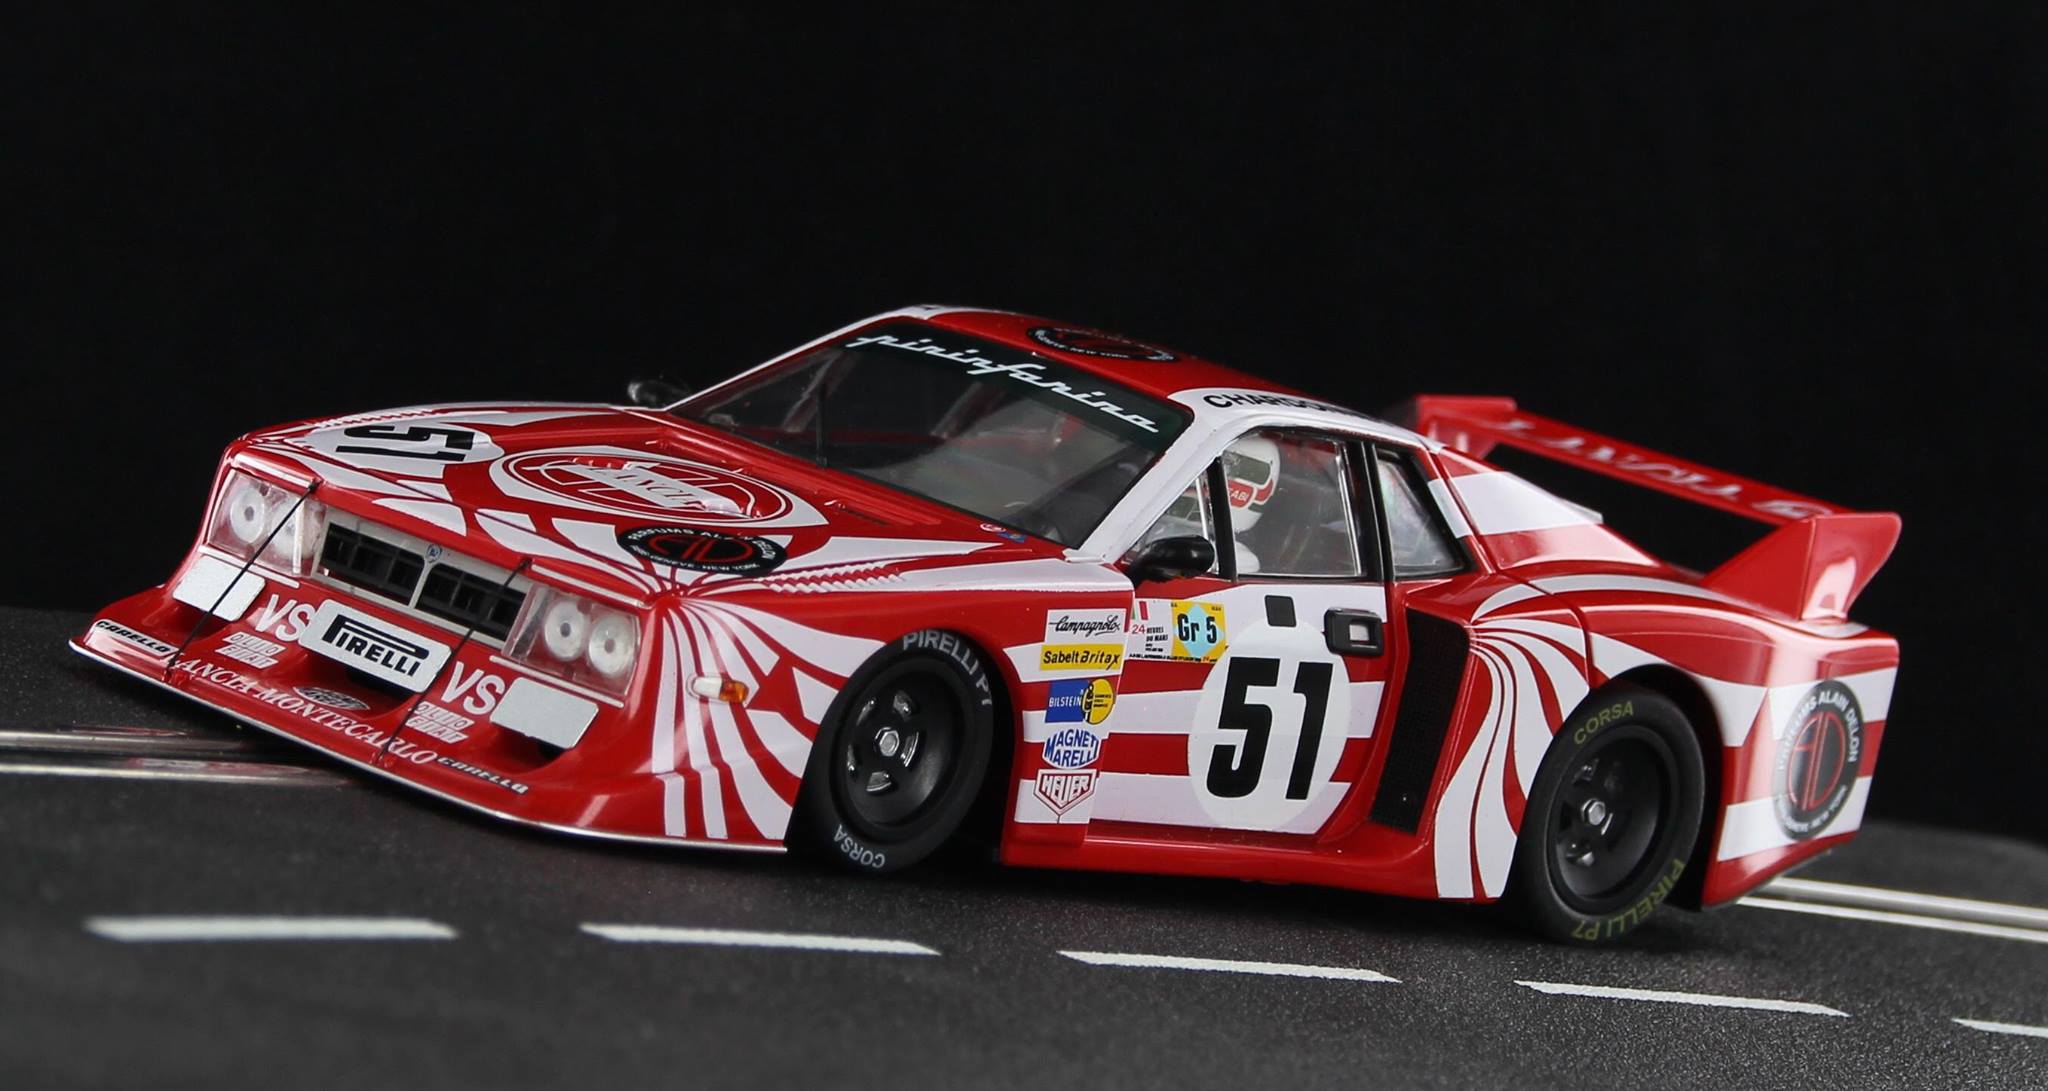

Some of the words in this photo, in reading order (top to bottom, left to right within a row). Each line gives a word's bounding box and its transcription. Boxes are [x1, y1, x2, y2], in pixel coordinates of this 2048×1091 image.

[846, 335, 1158, 433] pininfarina
[336, 425, 475, 462] 51
[97, 620, 174, 653] CARELLO
[254, 593, 317, 642] VS
[1049, 615, 1120, 637] Campagnolo
[1132, 624, 1146, 634] 24
[1177, 613, 1200, 642] Gr
[1206, 616, 1217, 644] 5
[321, 614, 430, 677] PIRELLI
[902, 629, 979, 676] PIRELLI
[1043, 651, 1080, 665] Sabelt
[1080, 651, 1120, 670] Britax
[441, 661, 506, 715] VS
[1049, 695, 1082, 707] BILSTEIN
[1206, 657, 1333, 800] 51
[1574, 701, 1635, 746] CORSA
[1042, 772, 1091, 803] HEUER
[833, 824, 886, 869] CORSA
[1606, 858, 1686, 938] PIRELLI
[1571, 919, 1601, 941] P7
